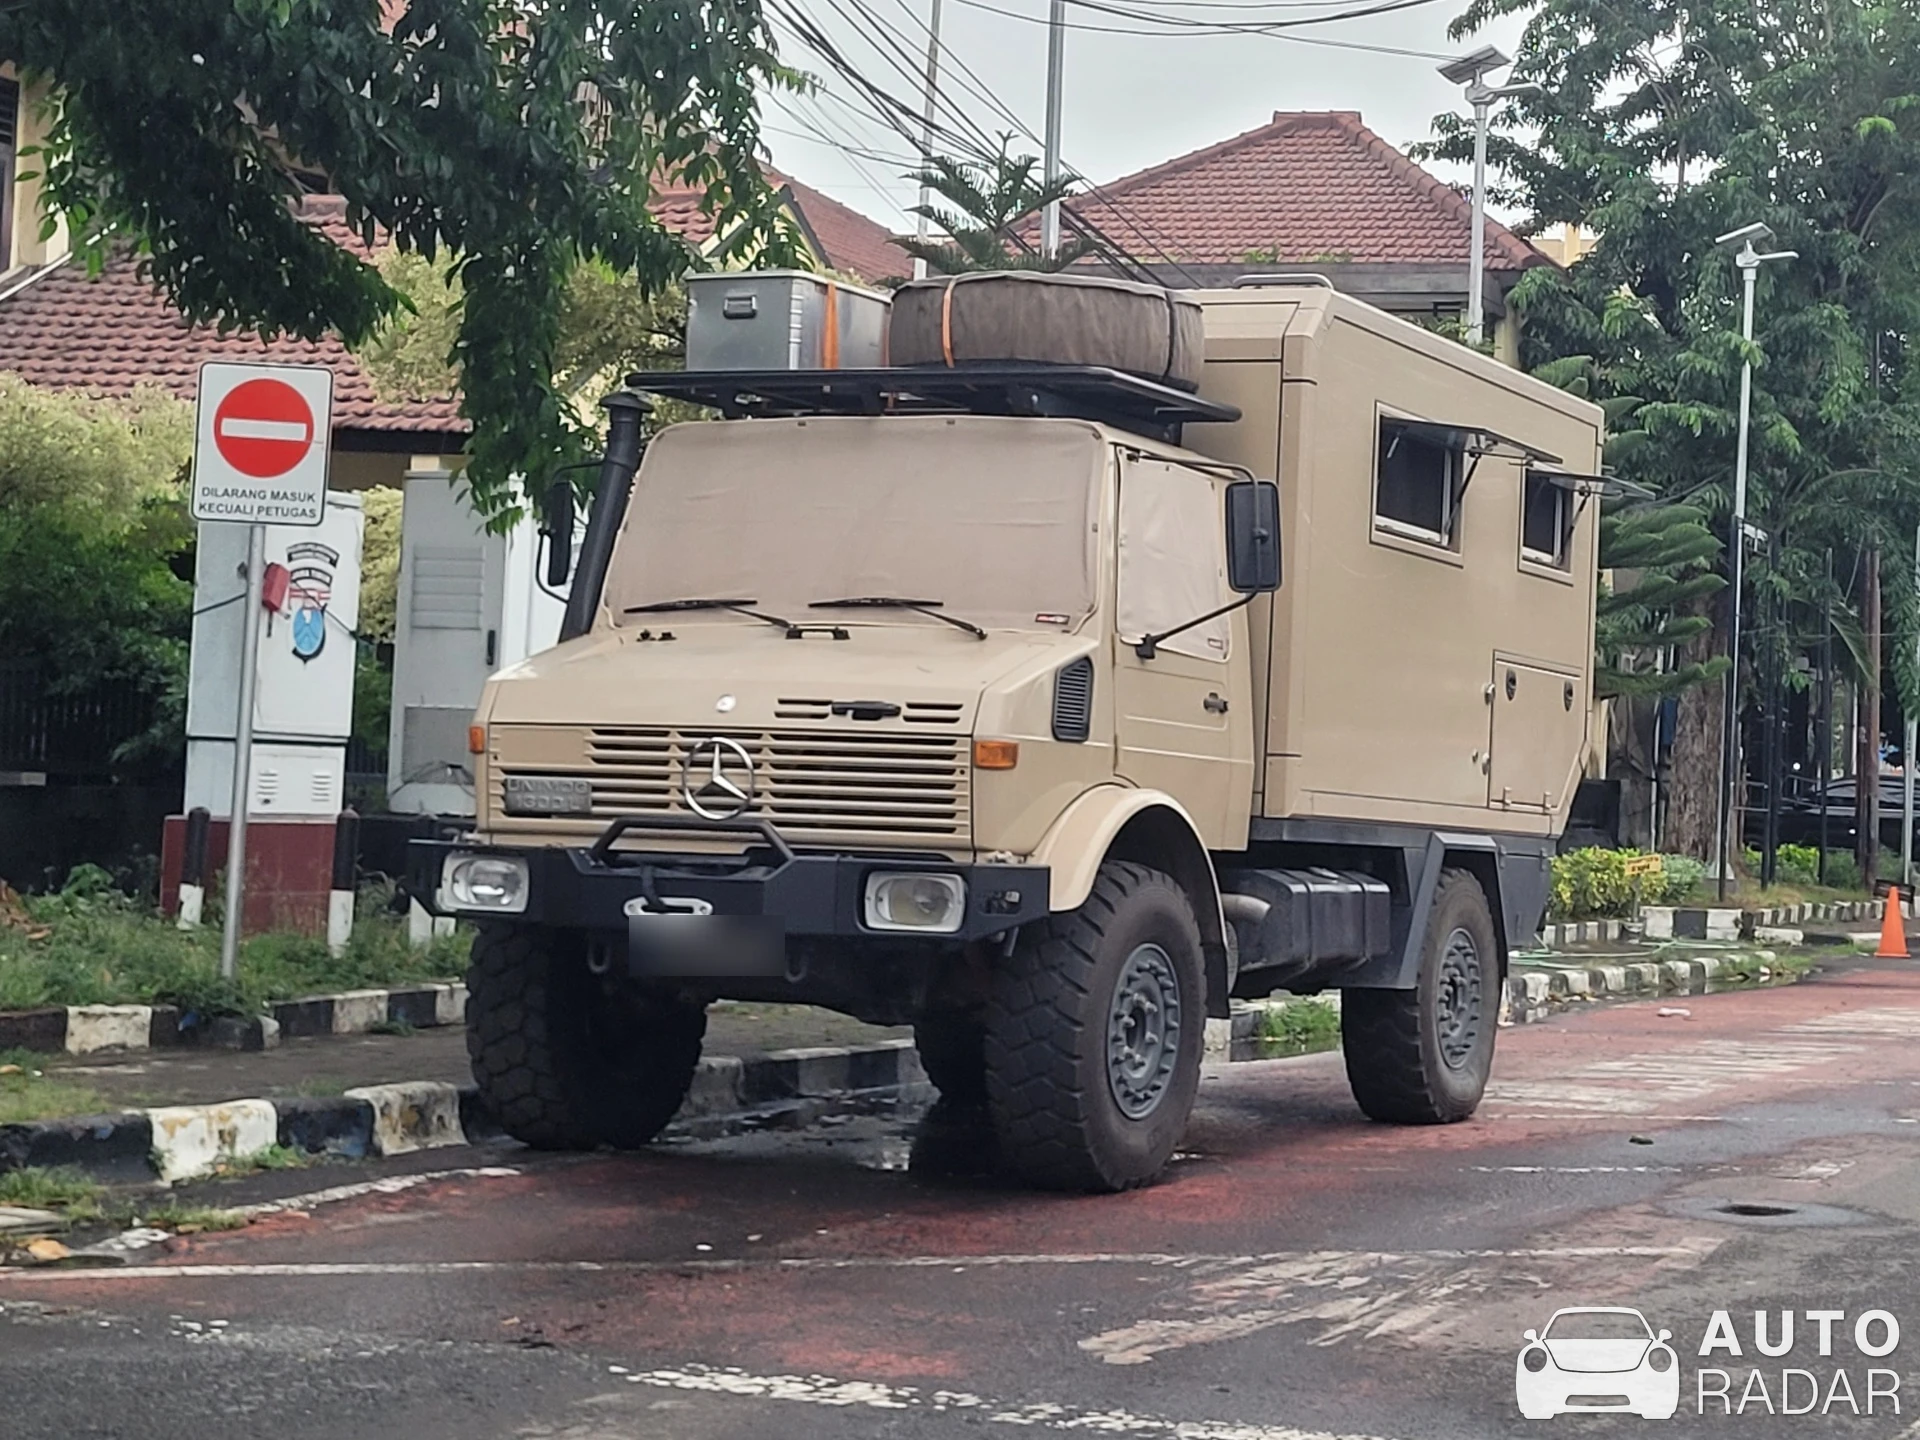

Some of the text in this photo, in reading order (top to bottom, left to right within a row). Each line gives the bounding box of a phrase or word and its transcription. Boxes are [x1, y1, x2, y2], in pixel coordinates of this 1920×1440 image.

[201, 487, 315, 503] DILARANG MASUK
[199, 502, 317, 518] KECUALI PETUGAS
